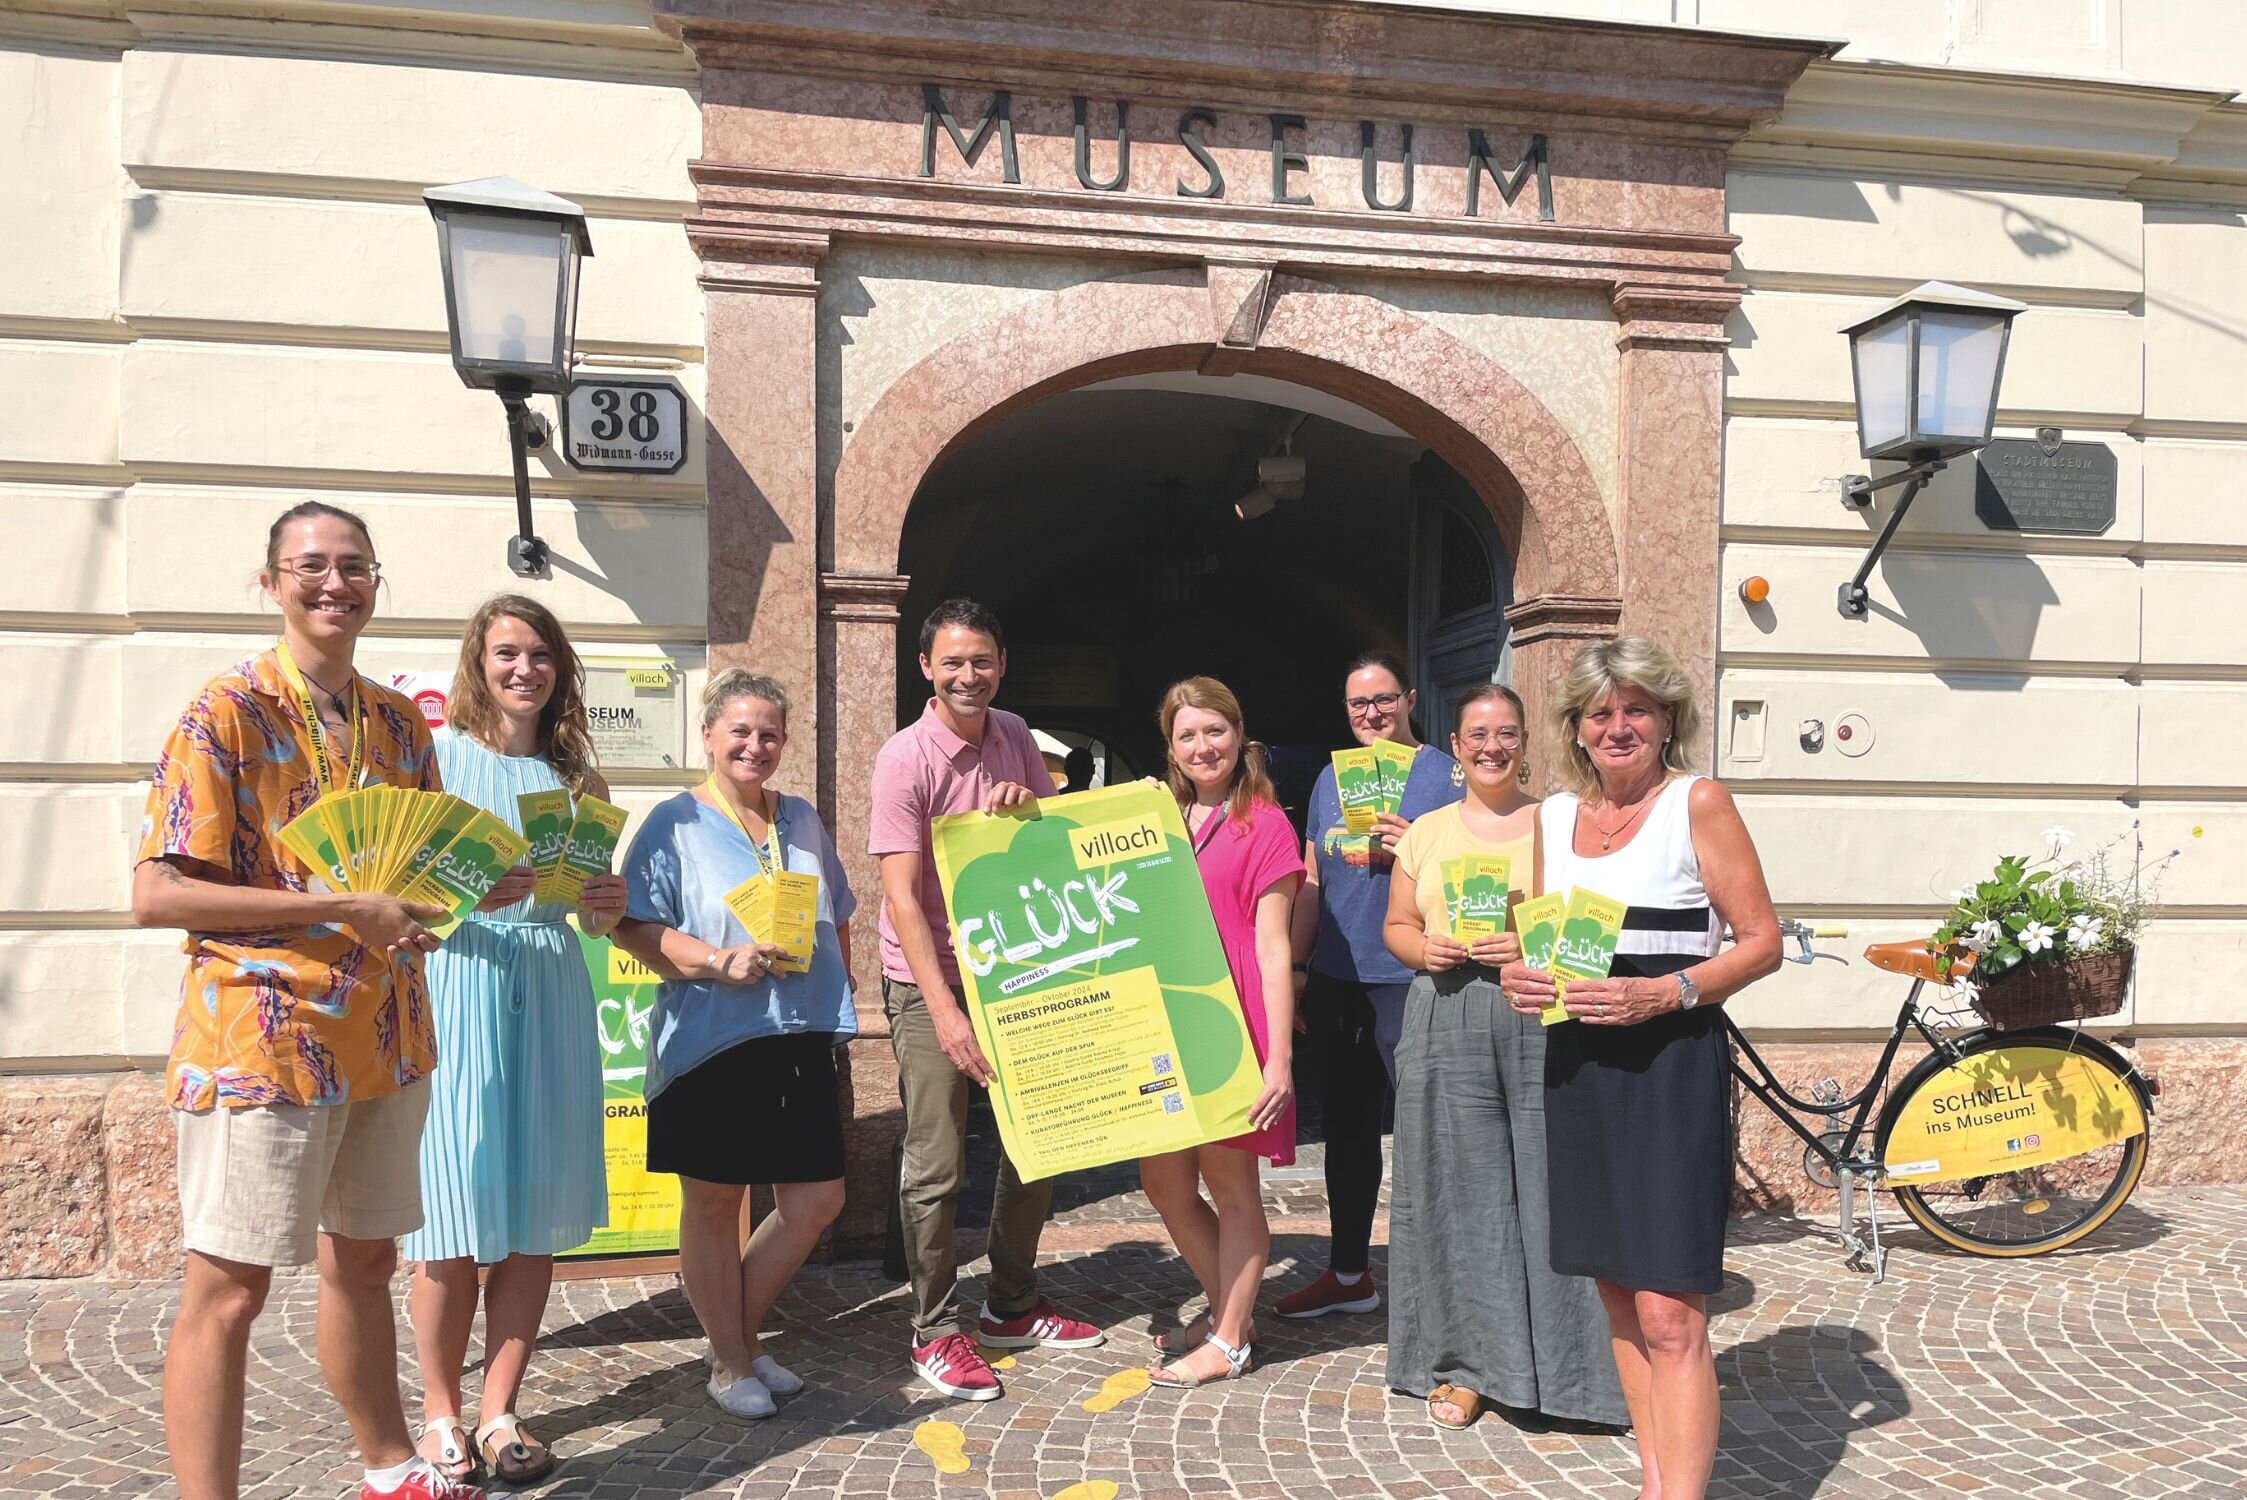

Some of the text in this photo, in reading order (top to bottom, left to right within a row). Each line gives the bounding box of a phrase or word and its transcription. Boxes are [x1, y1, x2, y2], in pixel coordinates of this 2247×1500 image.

[916, 85, 1556, 222] MUSEUM
[591, 389, 659, 442] 38
[577, 443, 675, 461] Widmann-Gasse
[2003, 455, 2093, 470] STADTMUSEUM
[630, 673, 664, 684] villach
[584, 707, 634, 719] SEUM
[303, 700, 328, 783] www.villach.at
[1340, 780, 1381, 800] GLÜCK
[488, 834, 513, 857] villach
[564, 838, 613, 862] GLÜCK
[1081, 824, 1158, 859] villach
[436, 852, 495, 894] GLÜCK
[1480, 866, 1502, 874] villach
[420, 884, 451, 908] PROGRAMM
[1460, 891, 1507, 910] GLÜCK
[958, 871, 1140, 976] GLÜCK
[1533, 908, 1557, 920] villach
[1588, 907, 1614, 922] villach
[1556, 937, 1615, 966] GLÜCK
[1004, 967, 1050, 991] HAPPINESS
[993, 998, 1034, 1015] September
[1041, 989, 1071, 1003] Oktober
[1071, 984, 1091, 995] 2024
[996, 990, 1111, 1025] HERBSTPROGRAMM
[1005, 1025, 1032, 1036] WELCHE
[1032, 1021, 1051, 1030] WEGE
[1051, 1017, 1066, 1025] ZUM
[1066, 1011, 1087, 1021] GLÜCK
[1088, 1008, 1102, 1016] GIBT
[1012, 1057, 1028, 1066] DEM
[1028, 1051, 1050, 1062] GLÜCK
[1064, 1045, 1078, 1053] DER
[1078, 1041, 1095, 1049] SPUR
[1019, 1078, 1070, 1095] AMBIVALENZEN
[1078, 1063, 1129, 1080] GLÜCKSBEGRIFF
[1063, 1100, 1085, 1110] NACHT
[1100, 1089, 1127, 1101] MUSEEN
[1932, 1083, 2033, 1115] SCHNELL
[1029, 1114, 1090, 1134] KURATORFÜHRUNG
[1090, 1108, 1112, 1119] GLÜCK
[1118, 1098, 1153, 1112] HAPPINESS
[1926, 1102, 2037, 1135] ins Museum!
[1065, 1138, 1094, 1149] OFFENEN
[1094, 1133, 1108, 1142] TÜR
